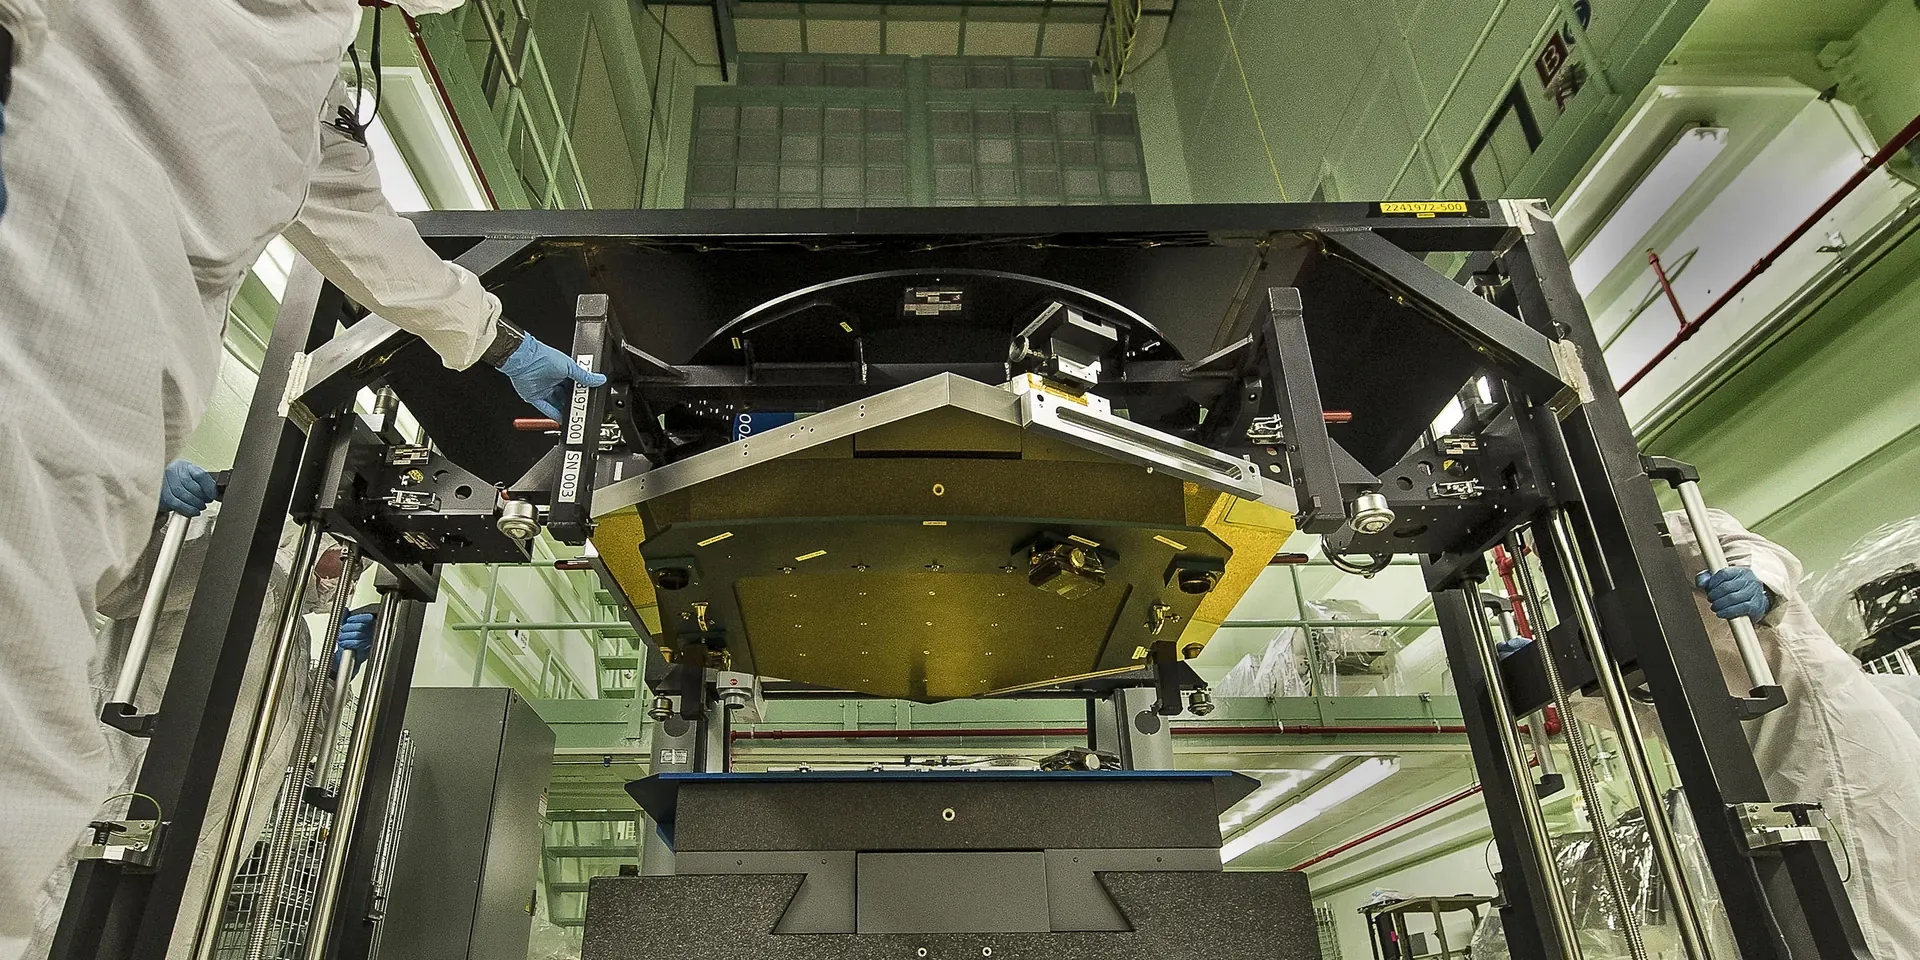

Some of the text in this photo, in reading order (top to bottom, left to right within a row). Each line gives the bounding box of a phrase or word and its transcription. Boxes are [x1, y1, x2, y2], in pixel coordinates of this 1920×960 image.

[1542, 45, 1560, 76] B
[1385, 203, 1462, 212] 2241972-500
[569, 359, 591, 440] 28197-500
[561, 453, 580, 498] SN 003
